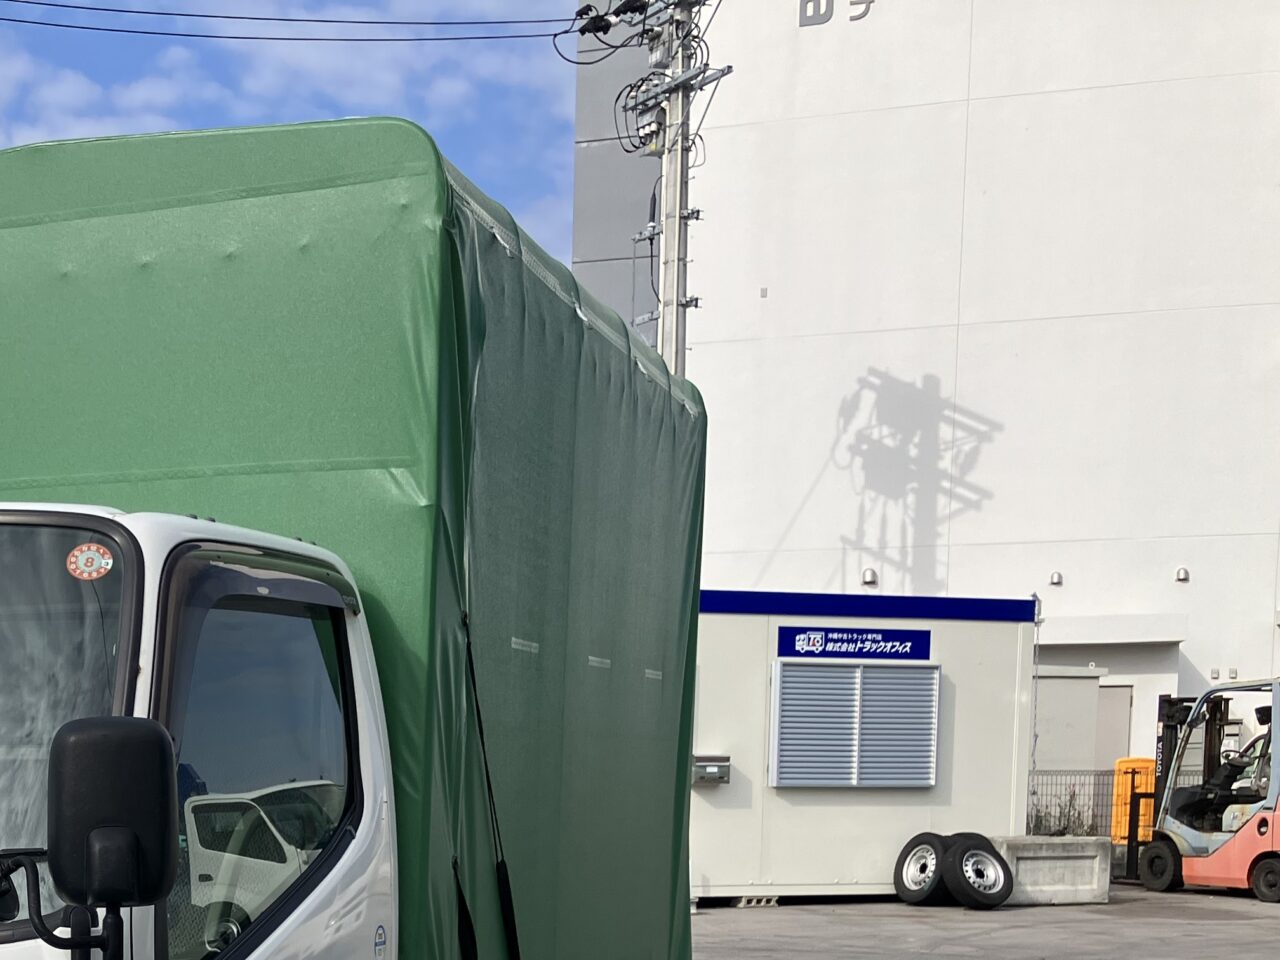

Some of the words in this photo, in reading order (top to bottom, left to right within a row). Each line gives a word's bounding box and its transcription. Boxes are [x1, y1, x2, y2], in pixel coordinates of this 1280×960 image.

[825, 641, 912, 653] 株式会社トラックオフィス
